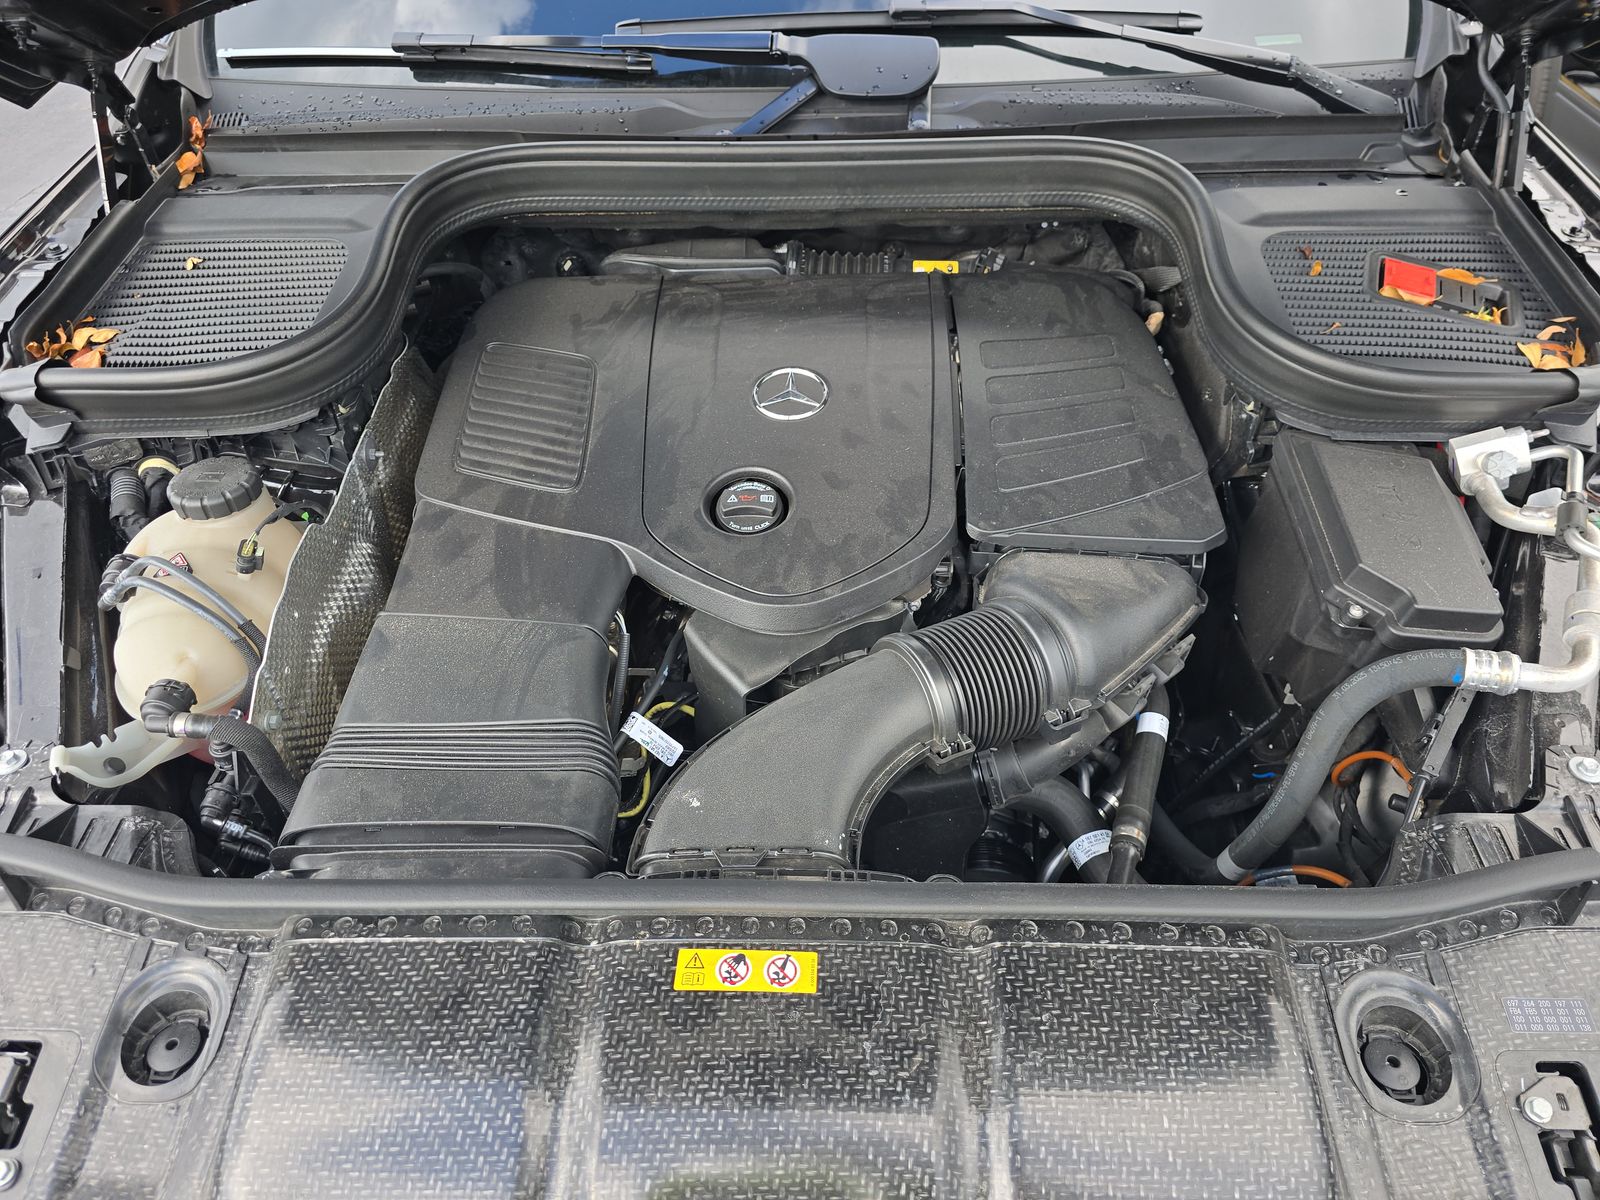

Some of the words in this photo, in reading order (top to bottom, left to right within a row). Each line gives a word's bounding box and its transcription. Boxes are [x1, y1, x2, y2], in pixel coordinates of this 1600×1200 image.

[1507, 999, 1519, 1007] 697
[1573, 1008, 1586, 1016] 100
[1543, 1016, 1557, 1024] 000
[1560, 1016, 1572, 1024] 001
[1576, 1016, 1589, 1024] 011
[1579, 1024, 1592, 1032] 138
